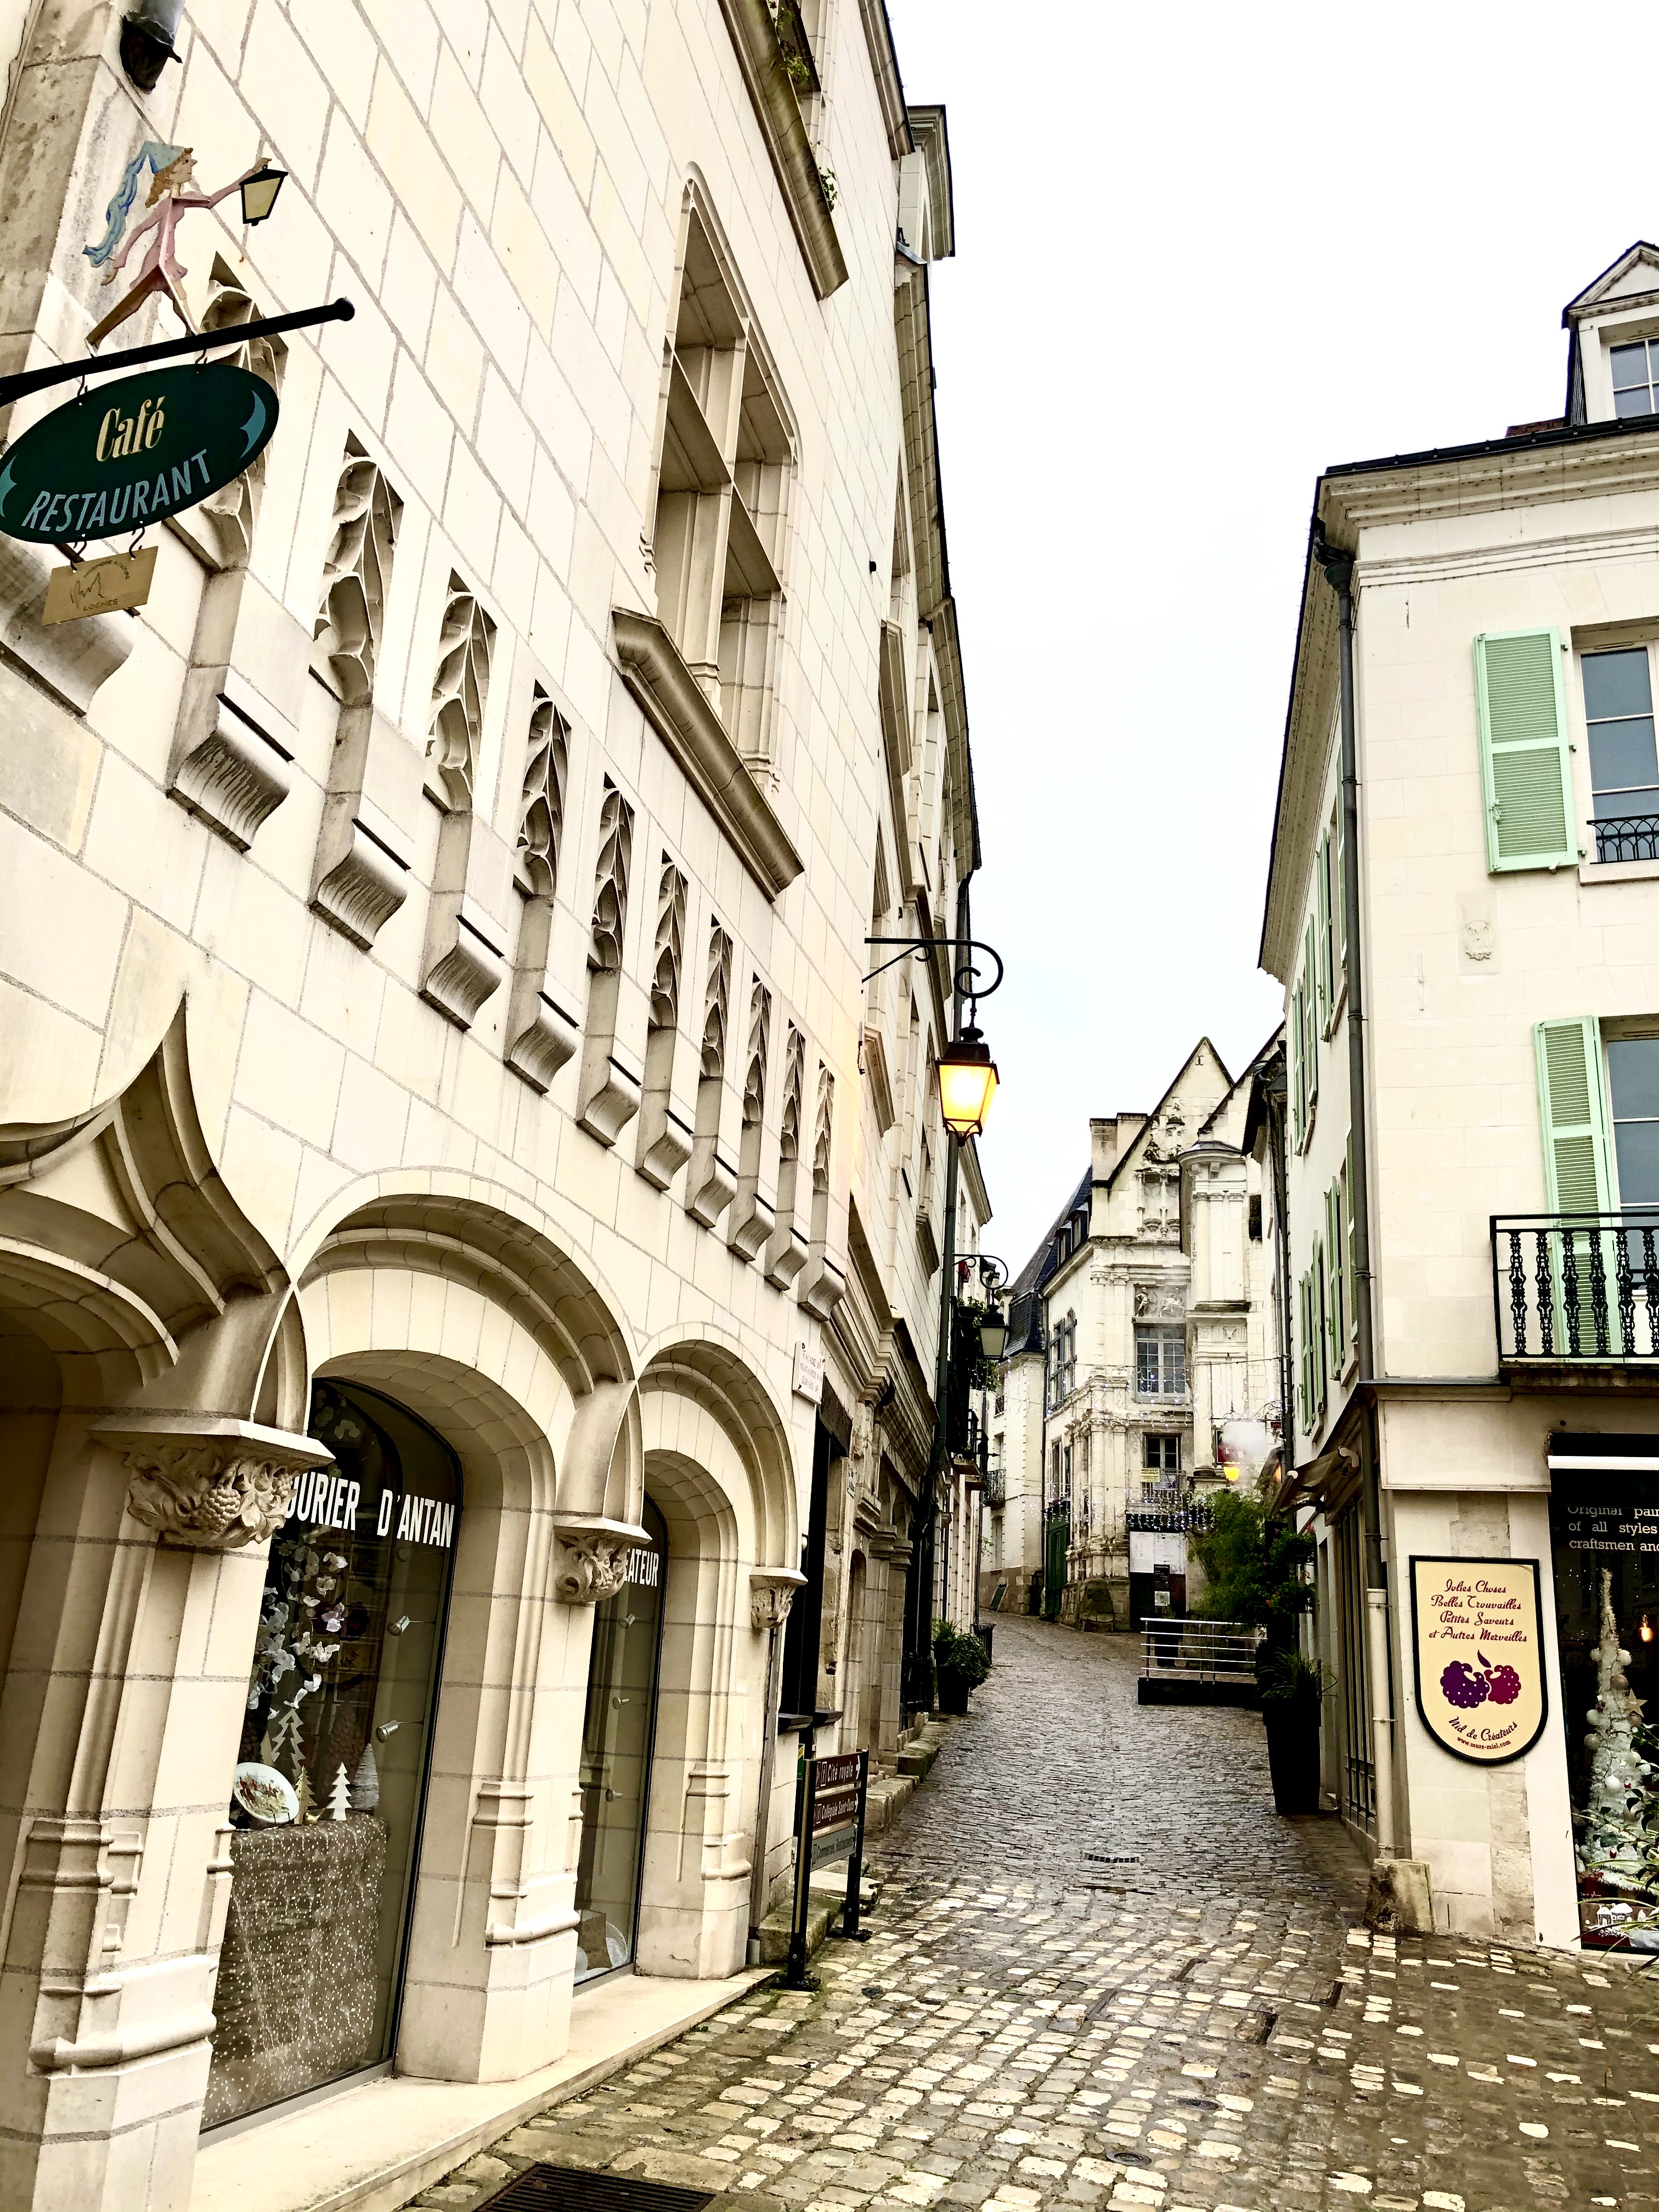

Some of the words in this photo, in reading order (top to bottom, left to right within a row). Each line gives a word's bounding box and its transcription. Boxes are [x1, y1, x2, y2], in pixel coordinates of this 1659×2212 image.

[96, 396, 165, 462] Café
[21, 449, 211, 532] RESTAURANT
[83, 599, 119, 612] LOCHES
[377, 1488, 455, 1548] D'ANTAN
[1568, 1521, 1581, 1531] of
[1592, 1521, 1608, 1532] all
[1619, 1522, 1658, 1536] styles
[1569, 1538, 1635, 1551] craftsmen
[1444, 1578, 1471, 1592] Jolies
[1475, 1580, 1506, 1593] Choses
[1431, 1594, 1463, 1607] Belles
[1466, 1595, 1521, 1610] Trouvailles
[1440, 1610, 1469, 1623] Petites
[1474, 1611, 1514, 1626] Saveurs
[1429, 1629, 1440, 1638] et
[1440, 1626, 1475, 1640] Autres
[1479, 1627, 1527, 1642] Merveilles
[1448, 1716, 1468, 1733] Nid
[1466, 1729, 1477, 1740] de
[1481, 1721, 1518, 1741] Créateurs
[1457, 1736, 1511, 1750] www.mure-miel.com
[827, 1763, 838, 1782] Cité
[839, 1760, 853, 1783] royale
